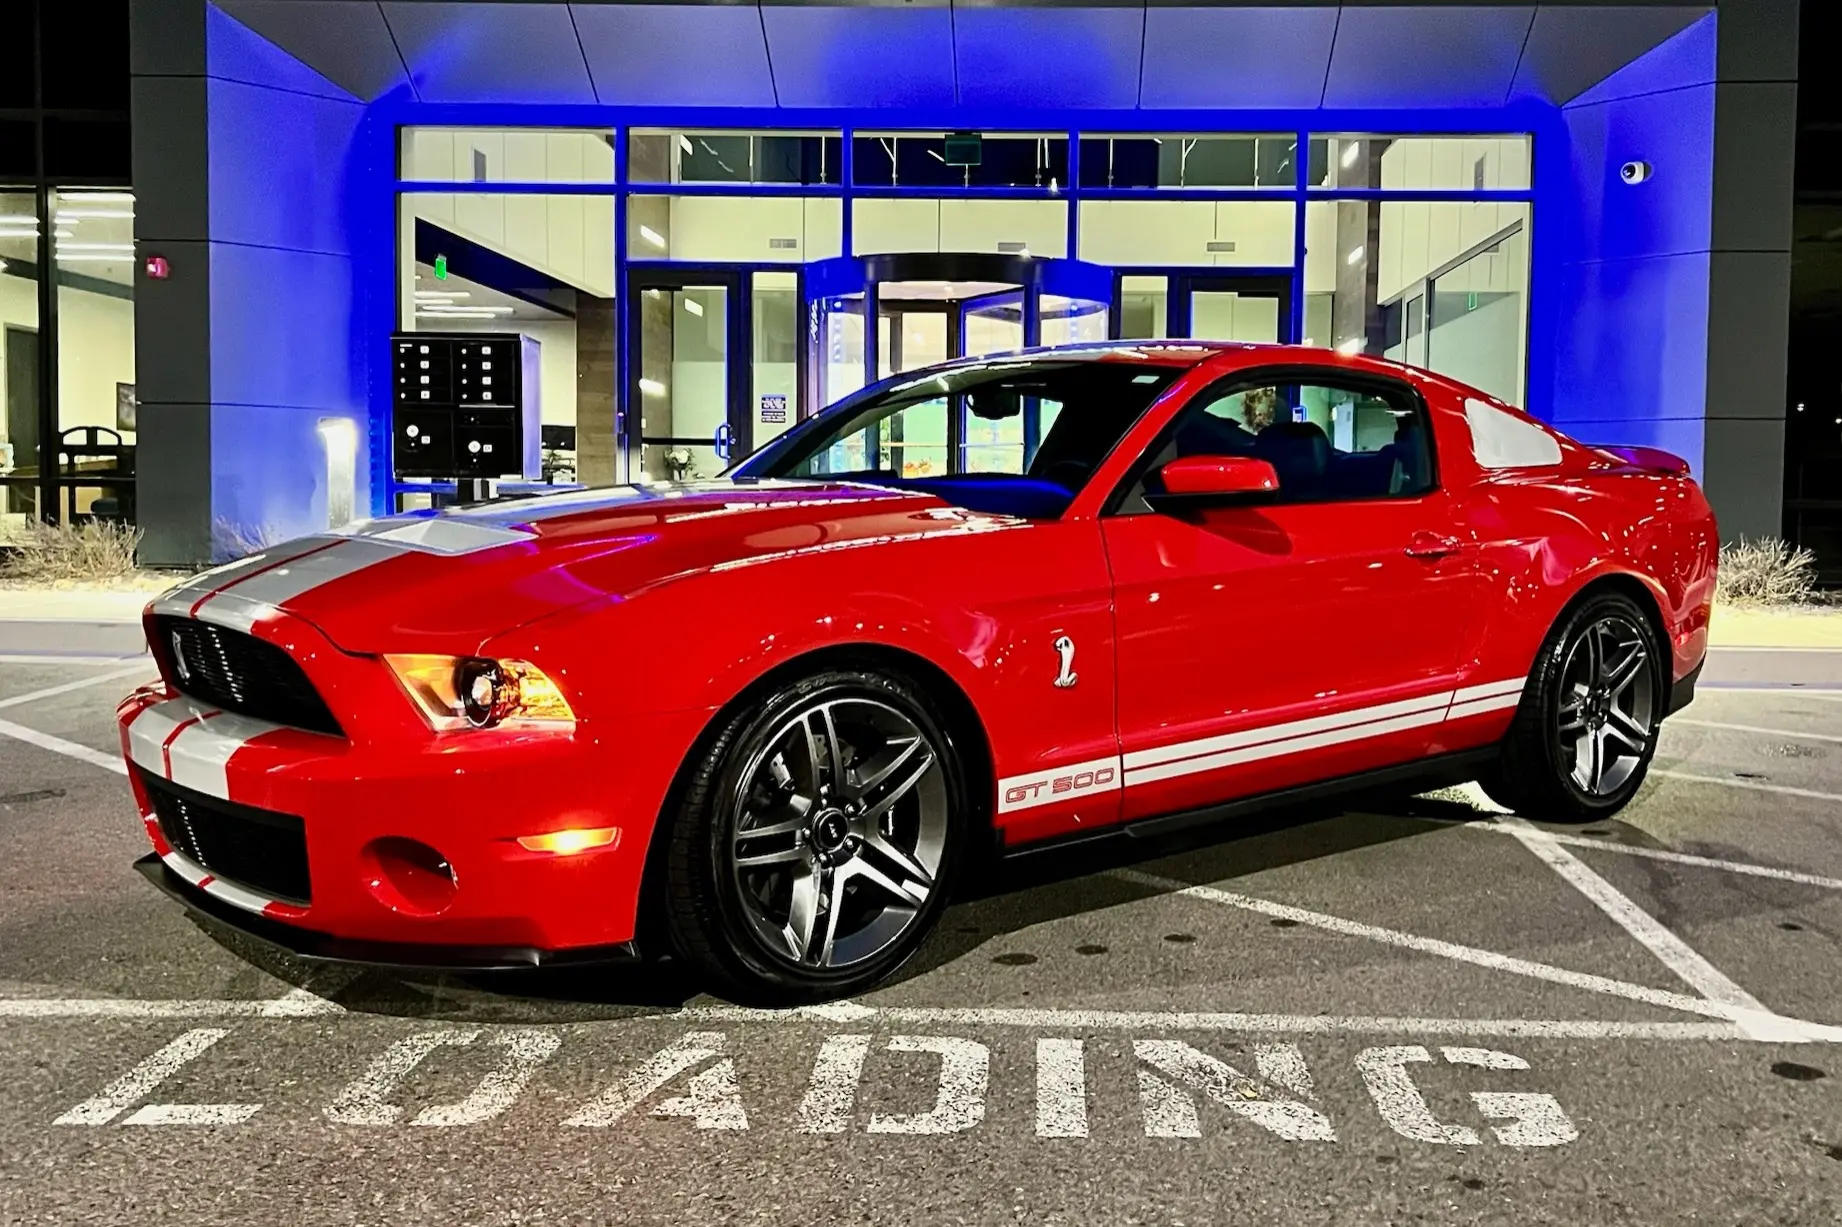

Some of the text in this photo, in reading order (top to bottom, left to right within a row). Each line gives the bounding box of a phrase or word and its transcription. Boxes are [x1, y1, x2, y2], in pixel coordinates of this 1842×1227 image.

[1005, 767, 1115, 803] GT 500
[52, 1028, 1578, 1147] LOADING
